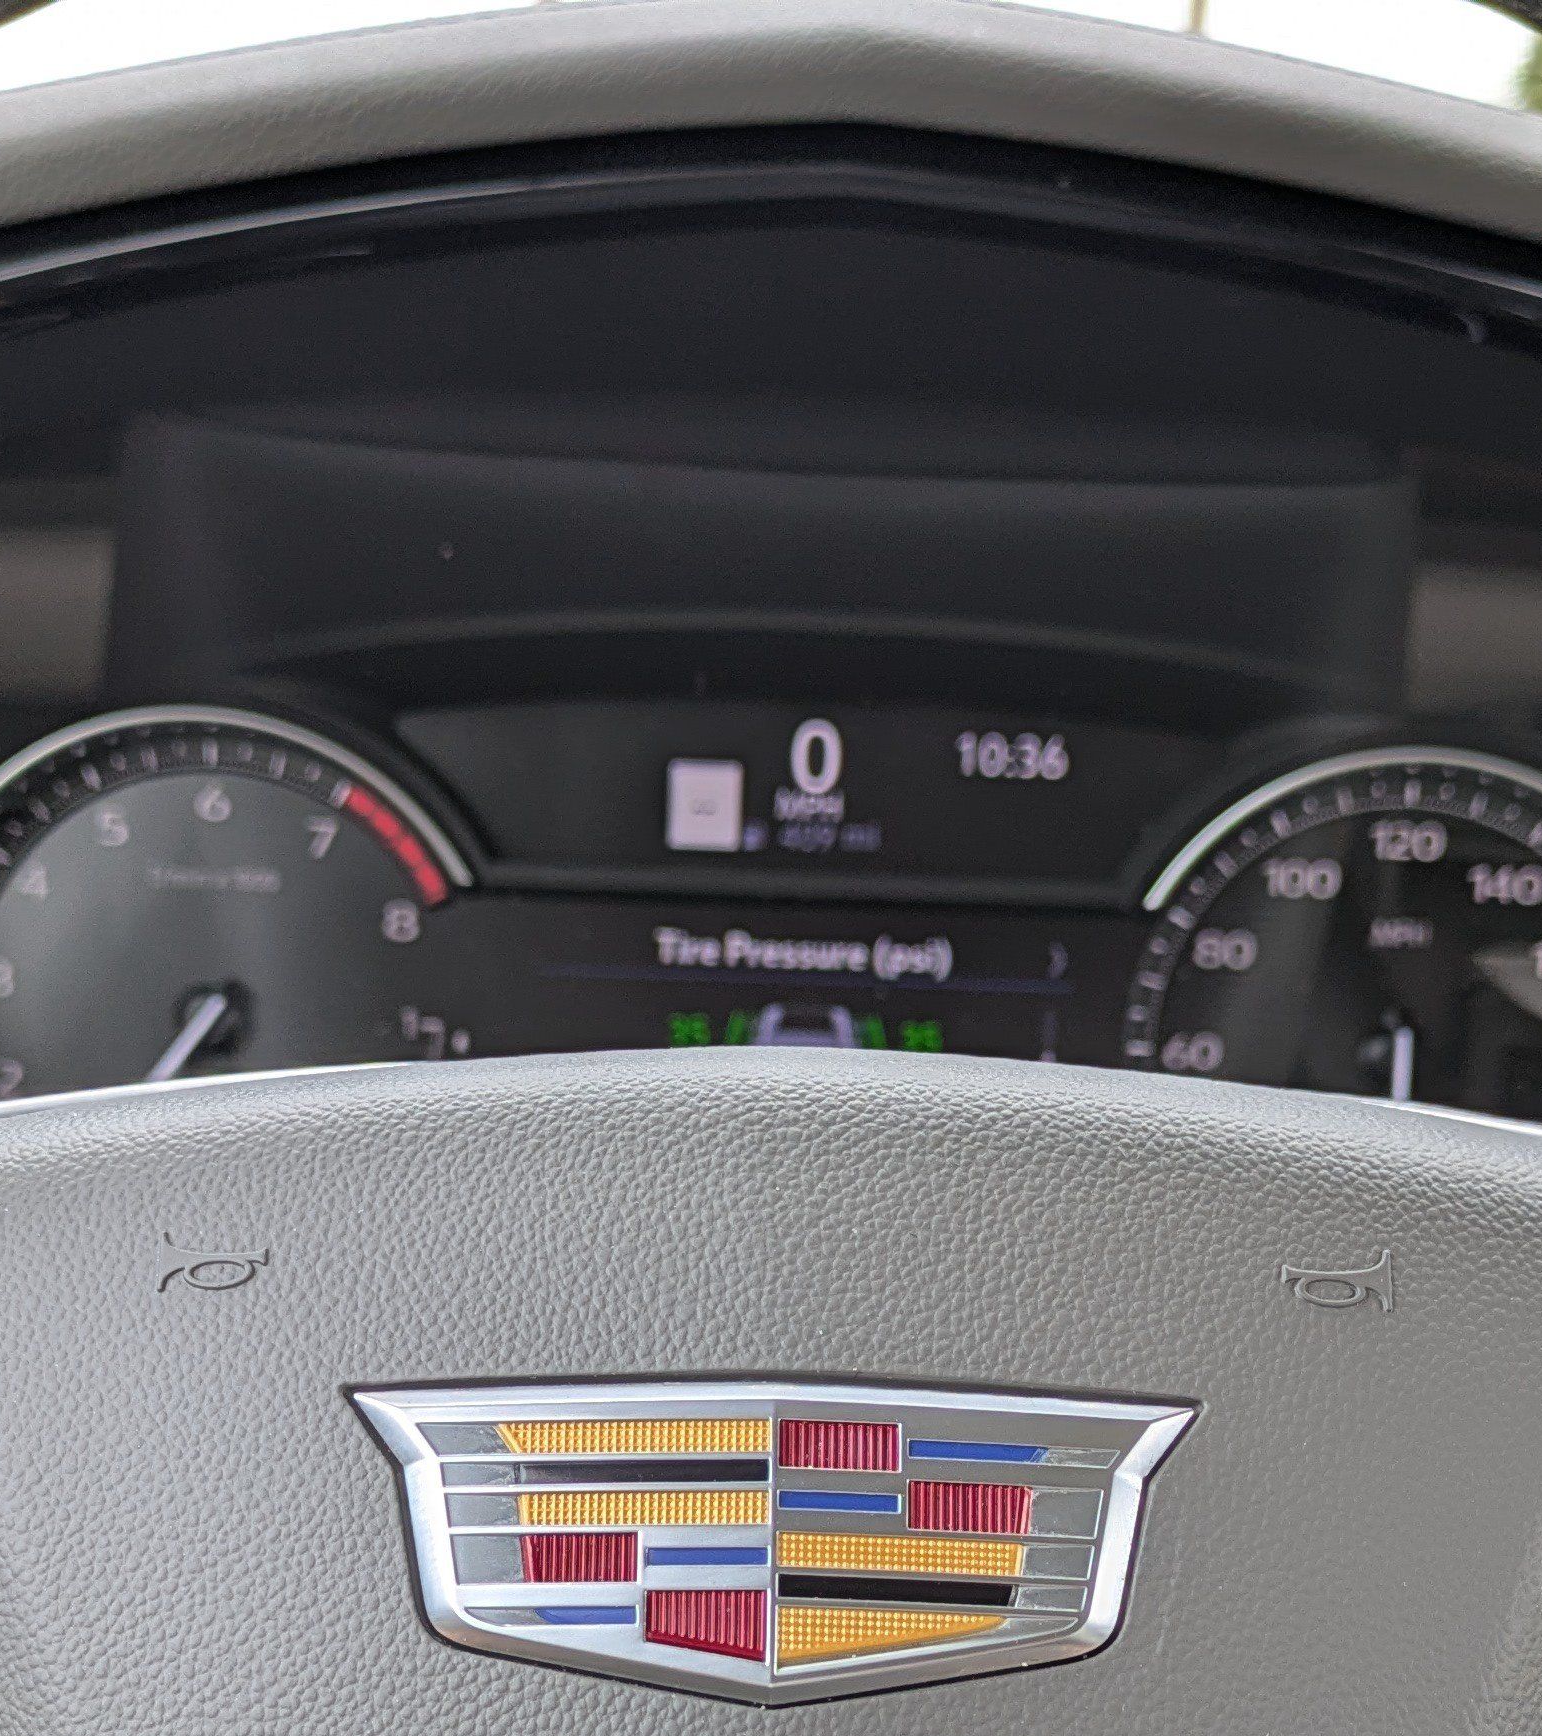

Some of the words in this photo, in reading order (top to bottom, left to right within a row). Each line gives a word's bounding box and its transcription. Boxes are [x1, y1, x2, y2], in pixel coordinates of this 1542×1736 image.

[791, 718, 842, 794] 0
[956, 730, 1069, 781] 10:36
[195, 784, 231, 822] 6
[99, 807, 130, 847] 5
[307, 816, 339, 859] 7
[1371, 820, 1448, 863] 120
[17, 862, 49, 898] 4
[1265, 858, 1343, 900] 100
[381, 899, 421, 943] 8
[656, 928, 721, 968] Tire
[724, 929, 868, 974] Pressure
[874, 935, 953, 982] (psi)
[1192, 928, 1258, 971] 80
[1162, 1032, 1225, 1073] 60
